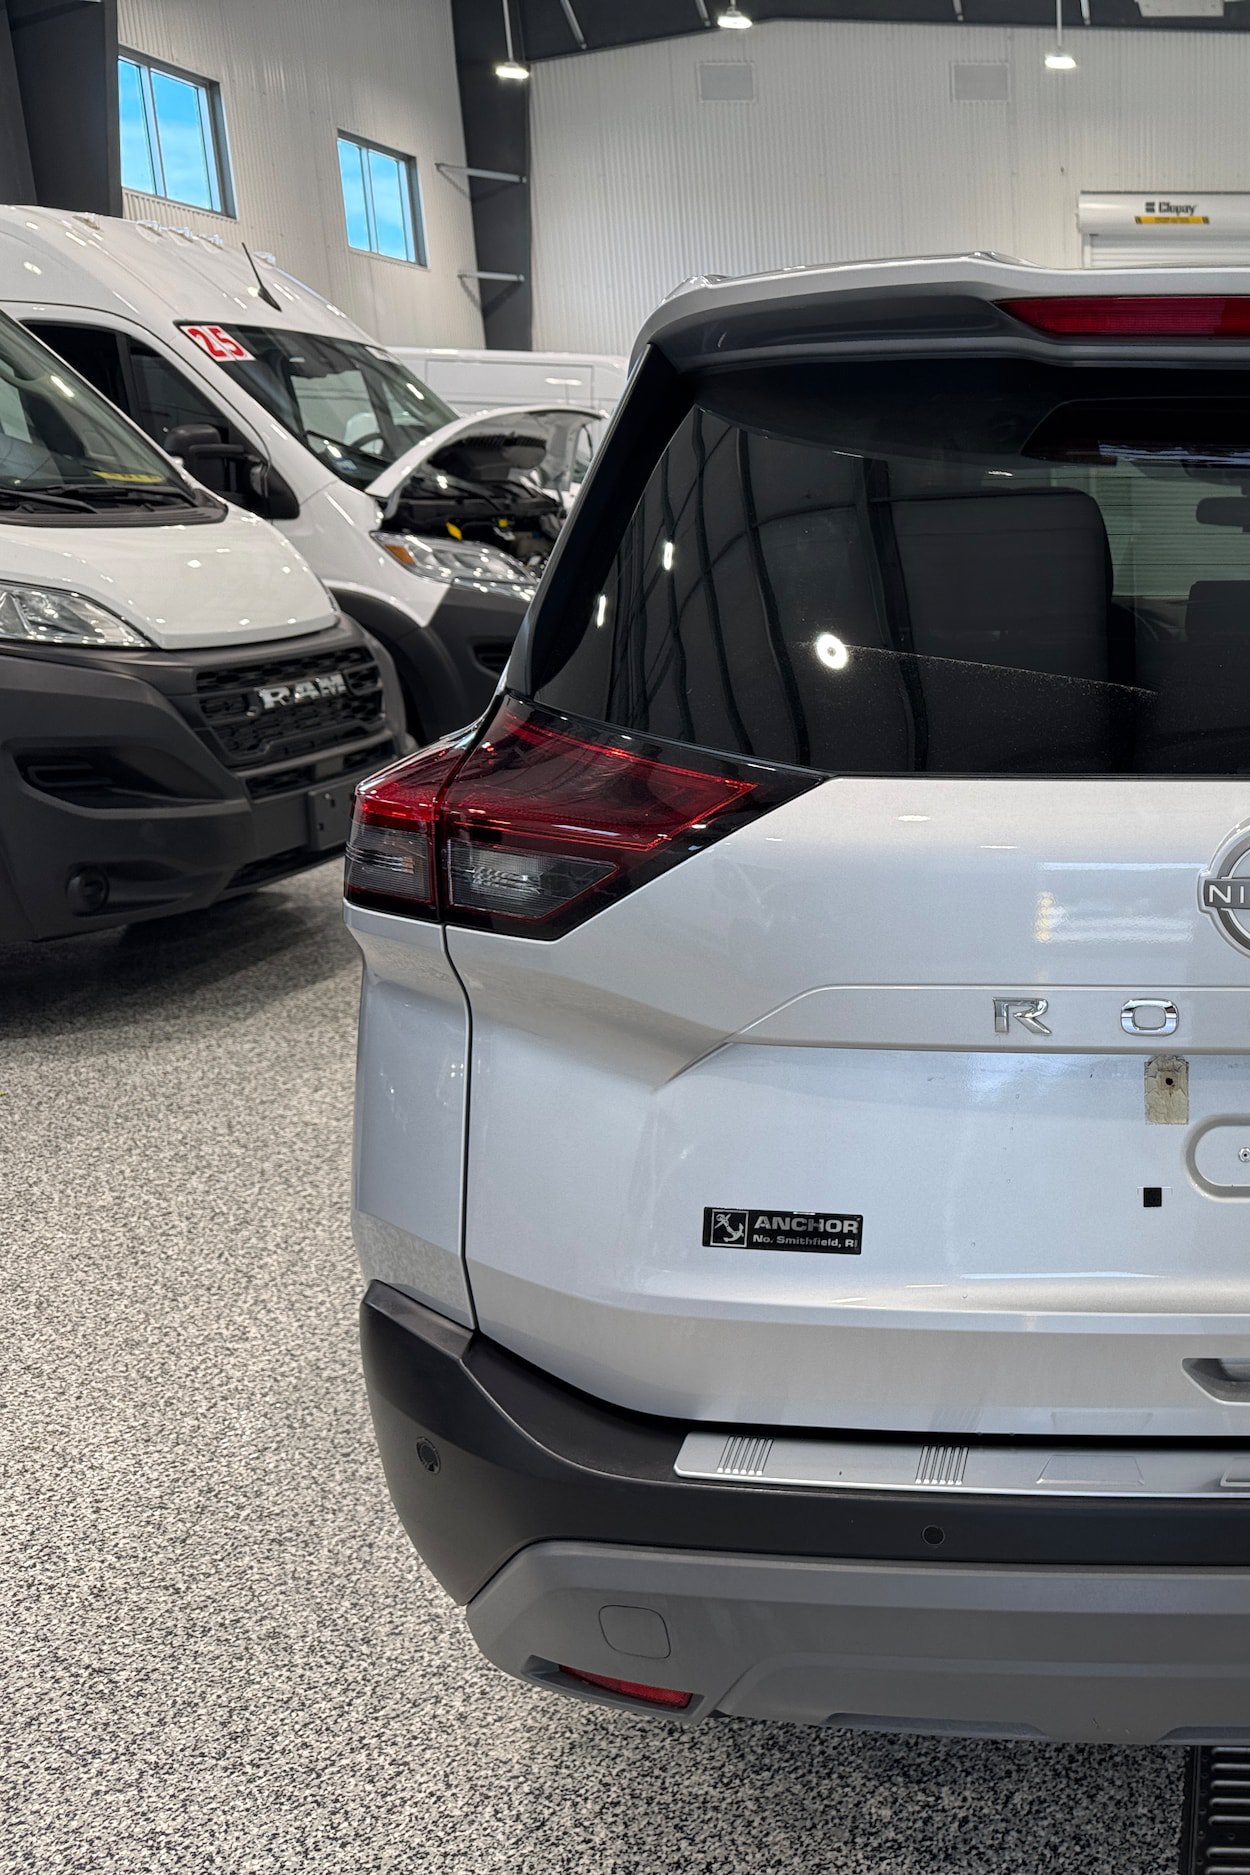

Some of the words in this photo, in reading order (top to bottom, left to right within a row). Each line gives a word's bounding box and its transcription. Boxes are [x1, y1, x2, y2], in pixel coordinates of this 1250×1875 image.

[187, 327, 245, 358] 25
[259, 674, 346, 709] RAM
[754, 1215, 859, 1234] ANCHOR
[752, 1234, 773, 1244] No.
[776, 1236, 842, 1248] Smithfield,
